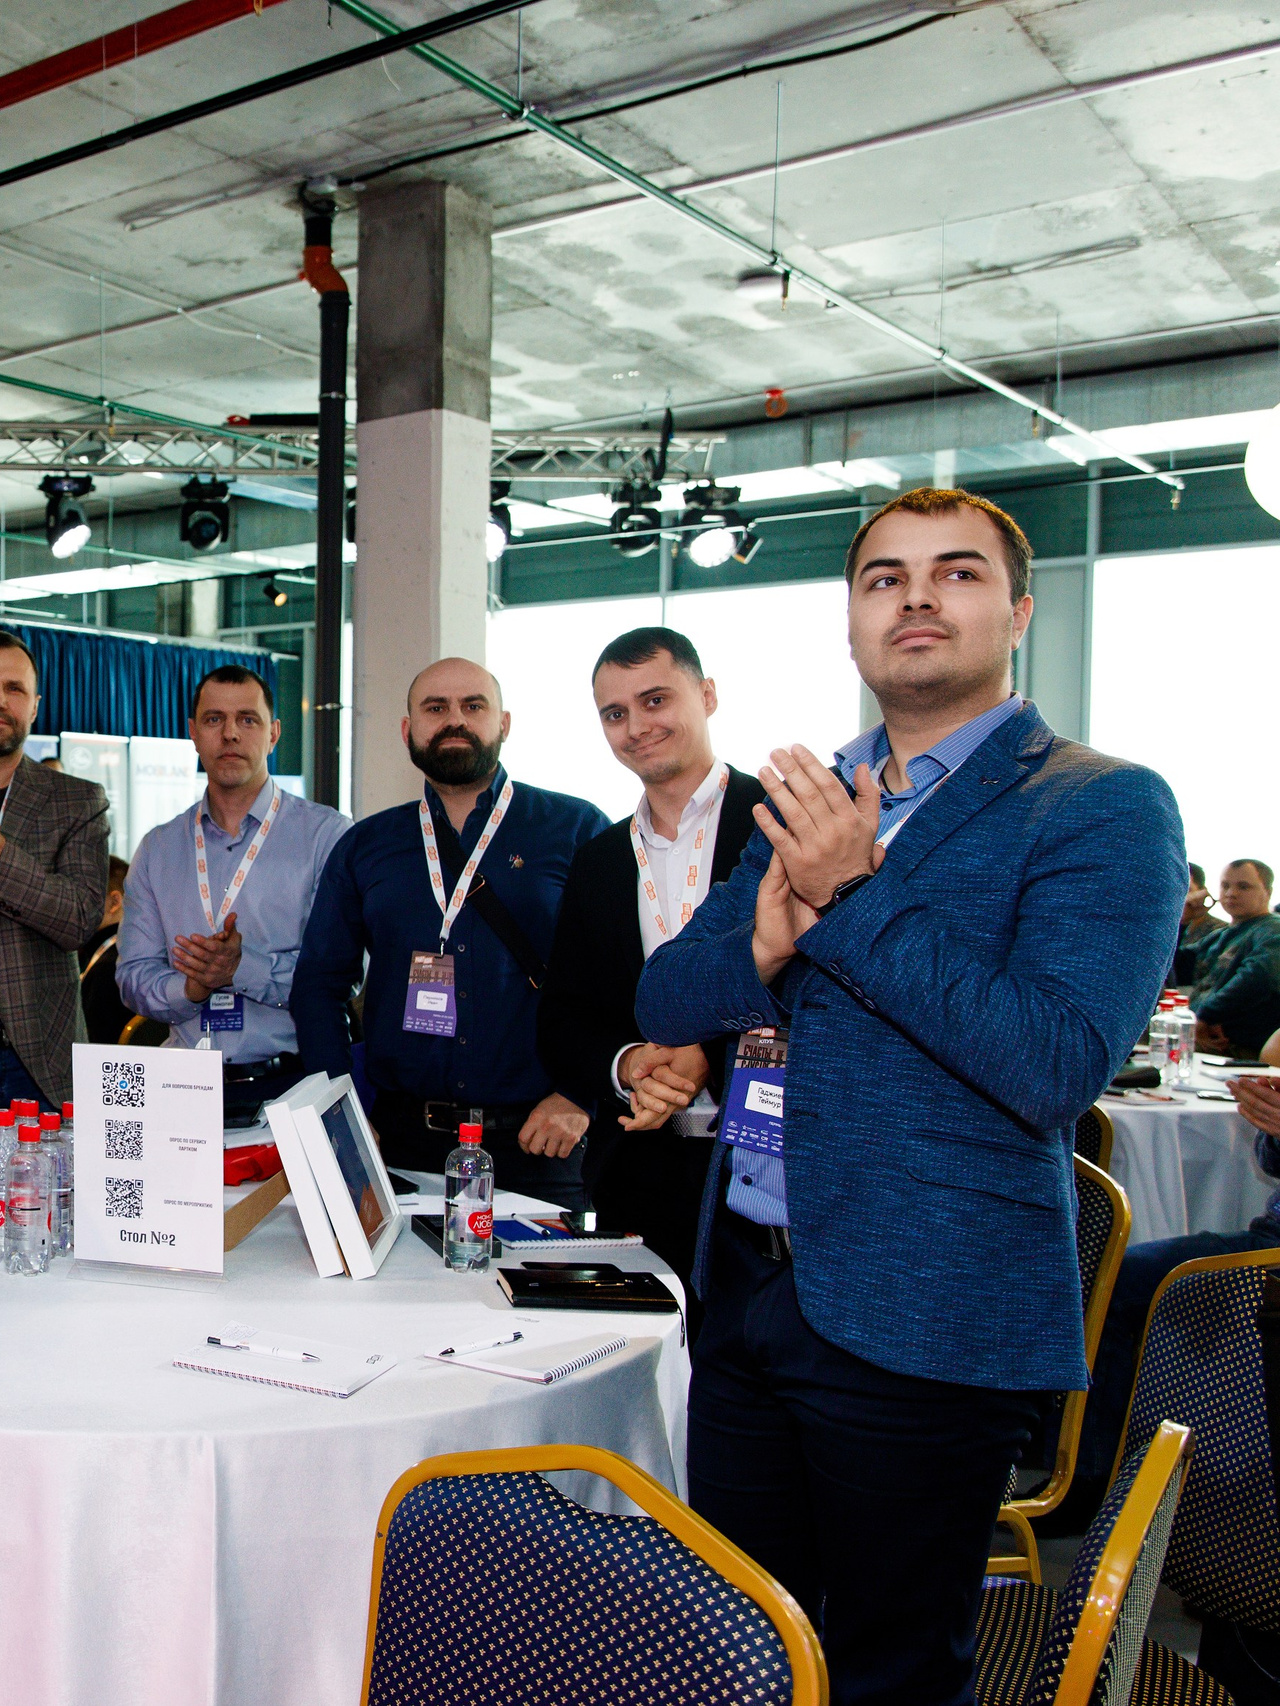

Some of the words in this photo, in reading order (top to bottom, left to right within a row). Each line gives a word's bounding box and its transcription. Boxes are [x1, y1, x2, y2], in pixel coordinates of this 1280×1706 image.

[744, 1044, 773, 1060] СЧАСТЬЕ
[758, 1087, 784, 1099] Гаджие
[758, 1096, 782, 1109] Теймур
[472, 1220, 492, 1229] ЛЮБ
[120, 1229, 147, 1243] Стол
